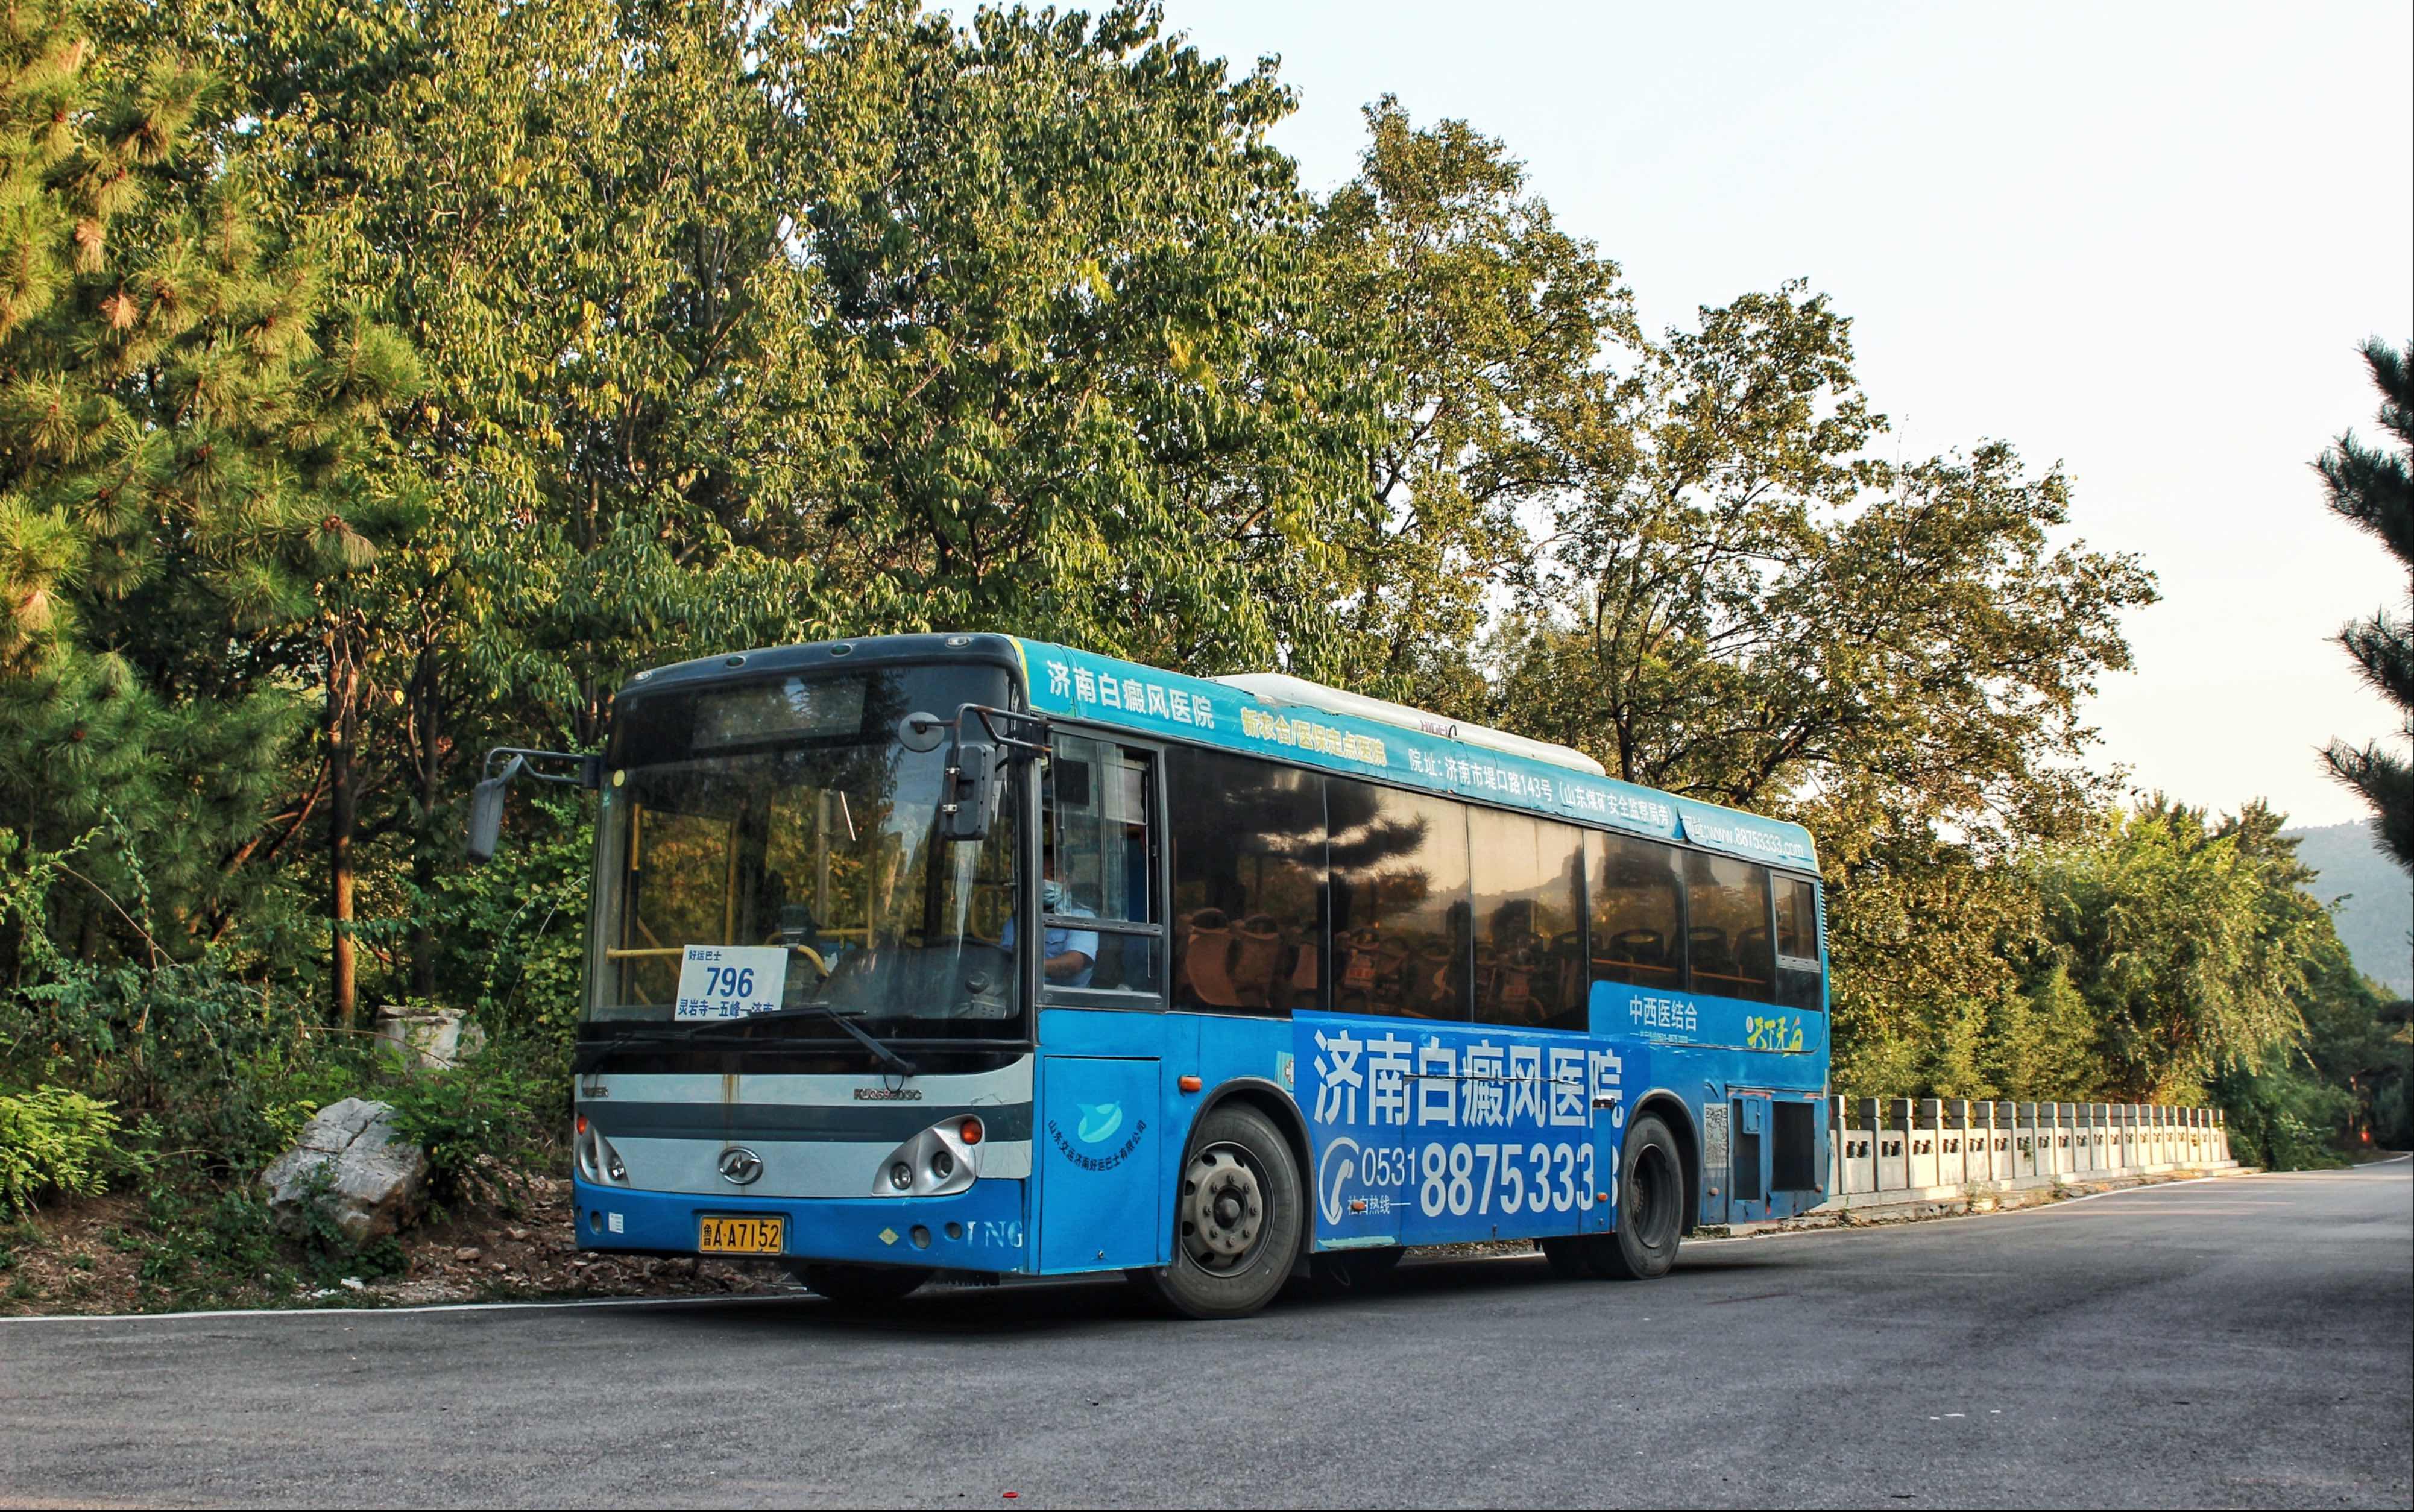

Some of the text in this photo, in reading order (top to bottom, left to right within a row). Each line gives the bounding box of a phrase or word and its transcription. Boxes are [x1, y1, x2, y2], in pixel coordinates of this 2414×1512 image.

[1047, 660, 1215, 729] 济南白癜风医院
[689, 950, 722, 961] 好运巴士
[706, 967, 754, 997] 796
[1630, 994, 1698, 1032] 中西医结合
[1314, 1028, 1624, 1129] 济南白癜风医院
[1361, 1147, 1416, 1186] 0531
